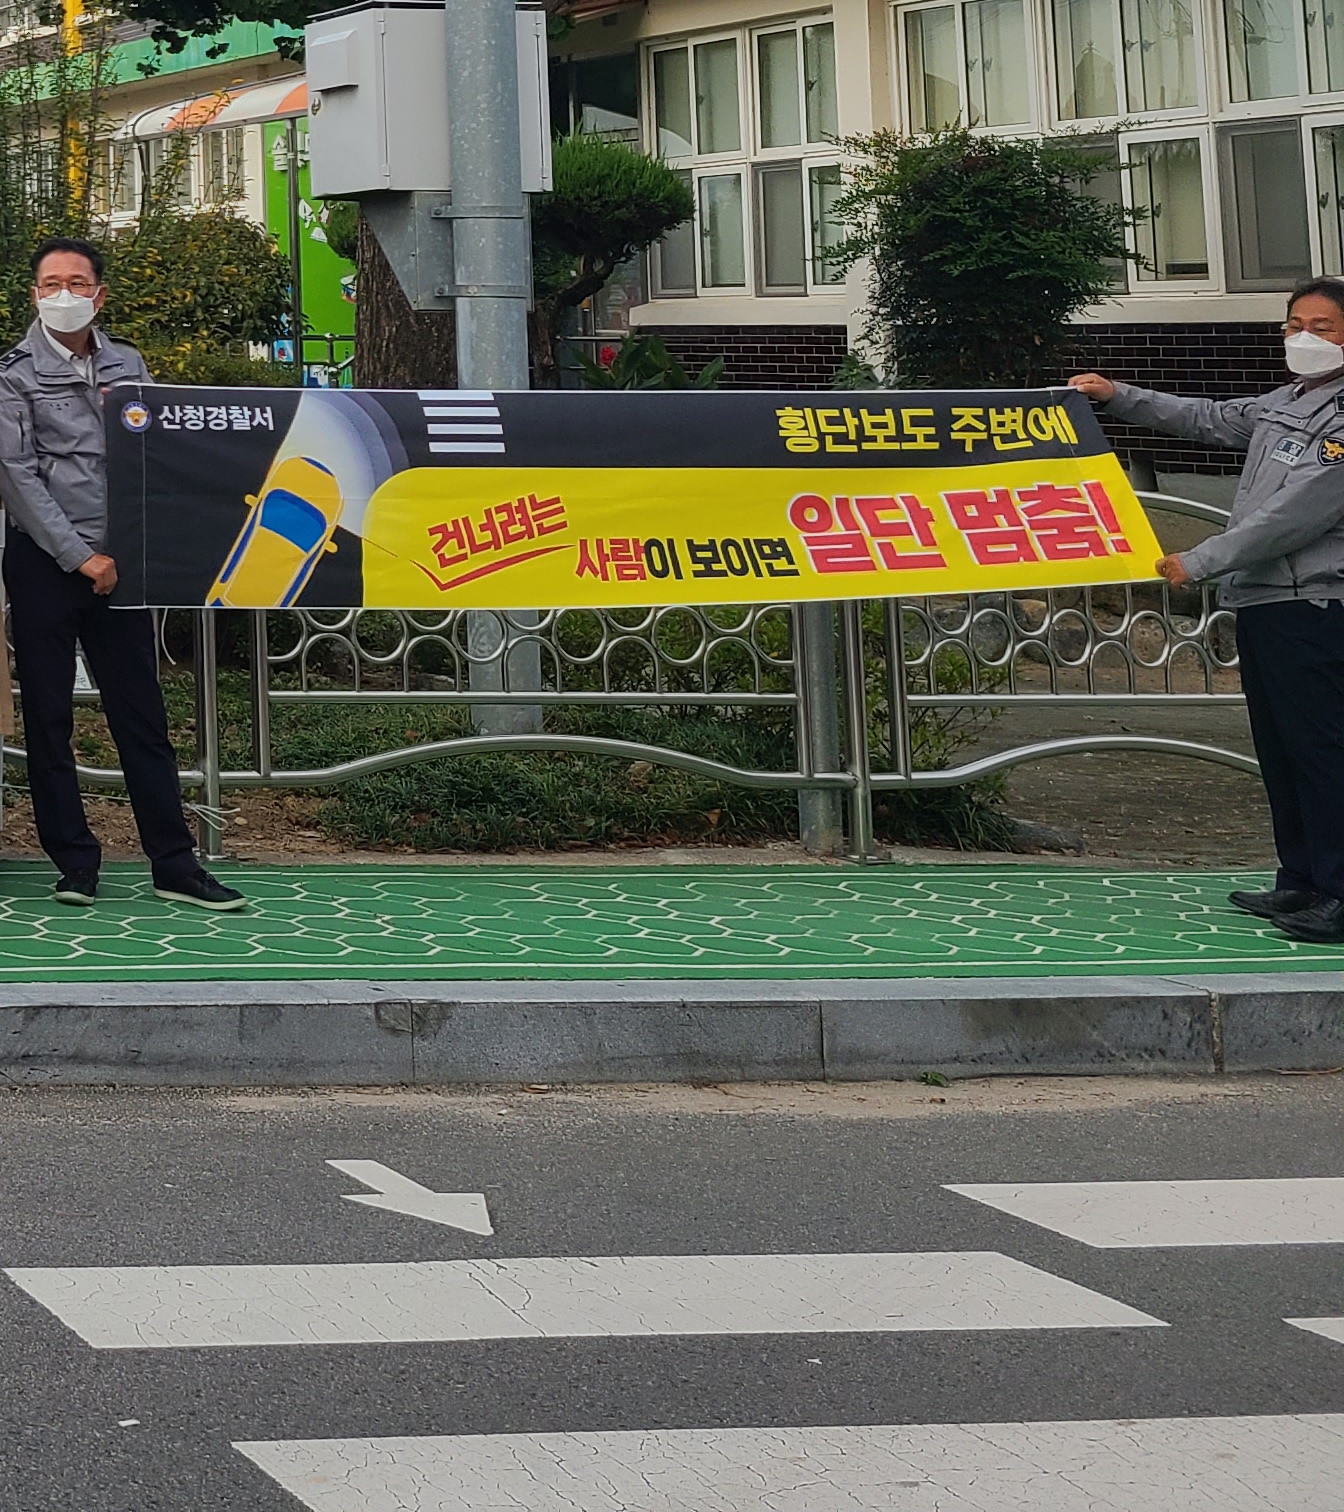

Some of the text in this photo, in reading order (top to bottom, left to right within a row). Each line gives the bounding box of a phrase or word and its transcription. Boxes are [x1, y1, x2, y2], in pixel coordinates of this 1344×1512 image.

[158, 404, 274, 431] 산청경찰서
[775, 405, 1079, 453] 횡단보도 주변에
[427, 480, 1133, 582] 건너려는 사람이 보이면 일단 멈춤!
